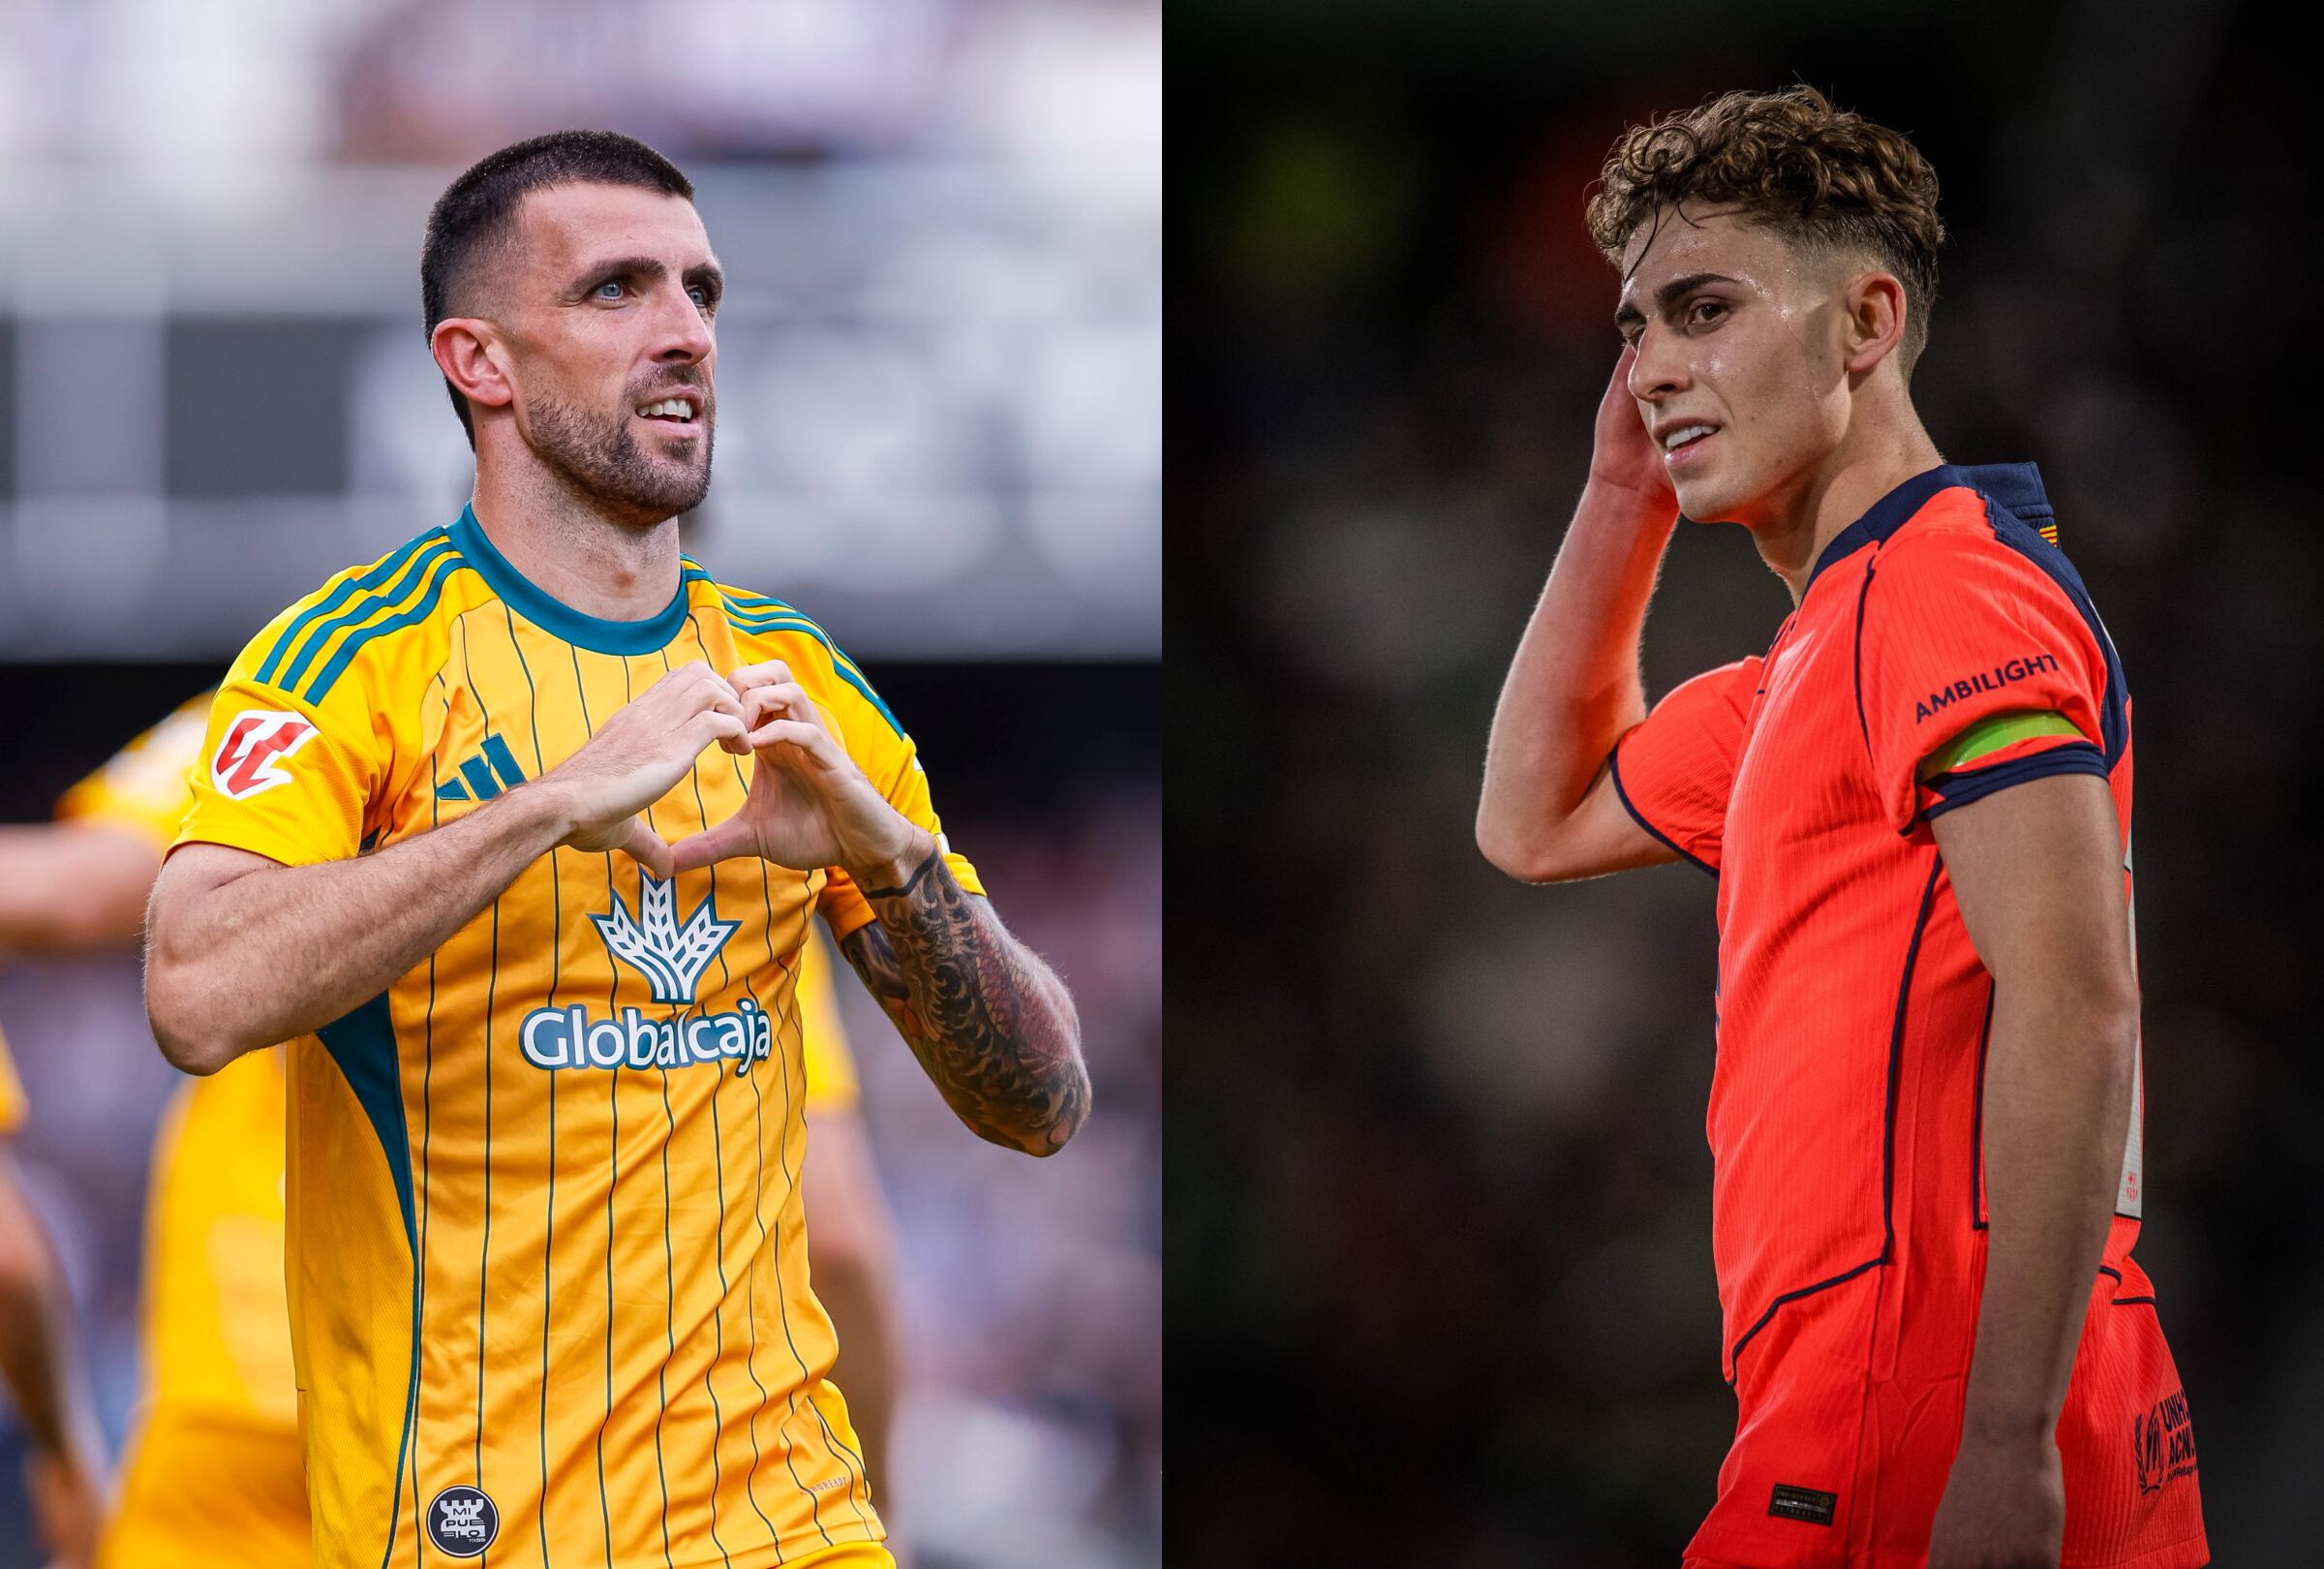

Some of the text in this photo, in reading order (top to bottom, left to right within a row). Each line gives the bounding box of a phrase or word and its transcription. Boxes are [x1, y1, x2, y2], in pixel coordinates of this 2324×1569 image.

[1916, 654, 2060, 724] AMBILIGHT
[523, 1000, 772, 1075] Globalcaja
[445, 1519, 485, 1527] PUE
[452, 1507, 471, 1516] MI
